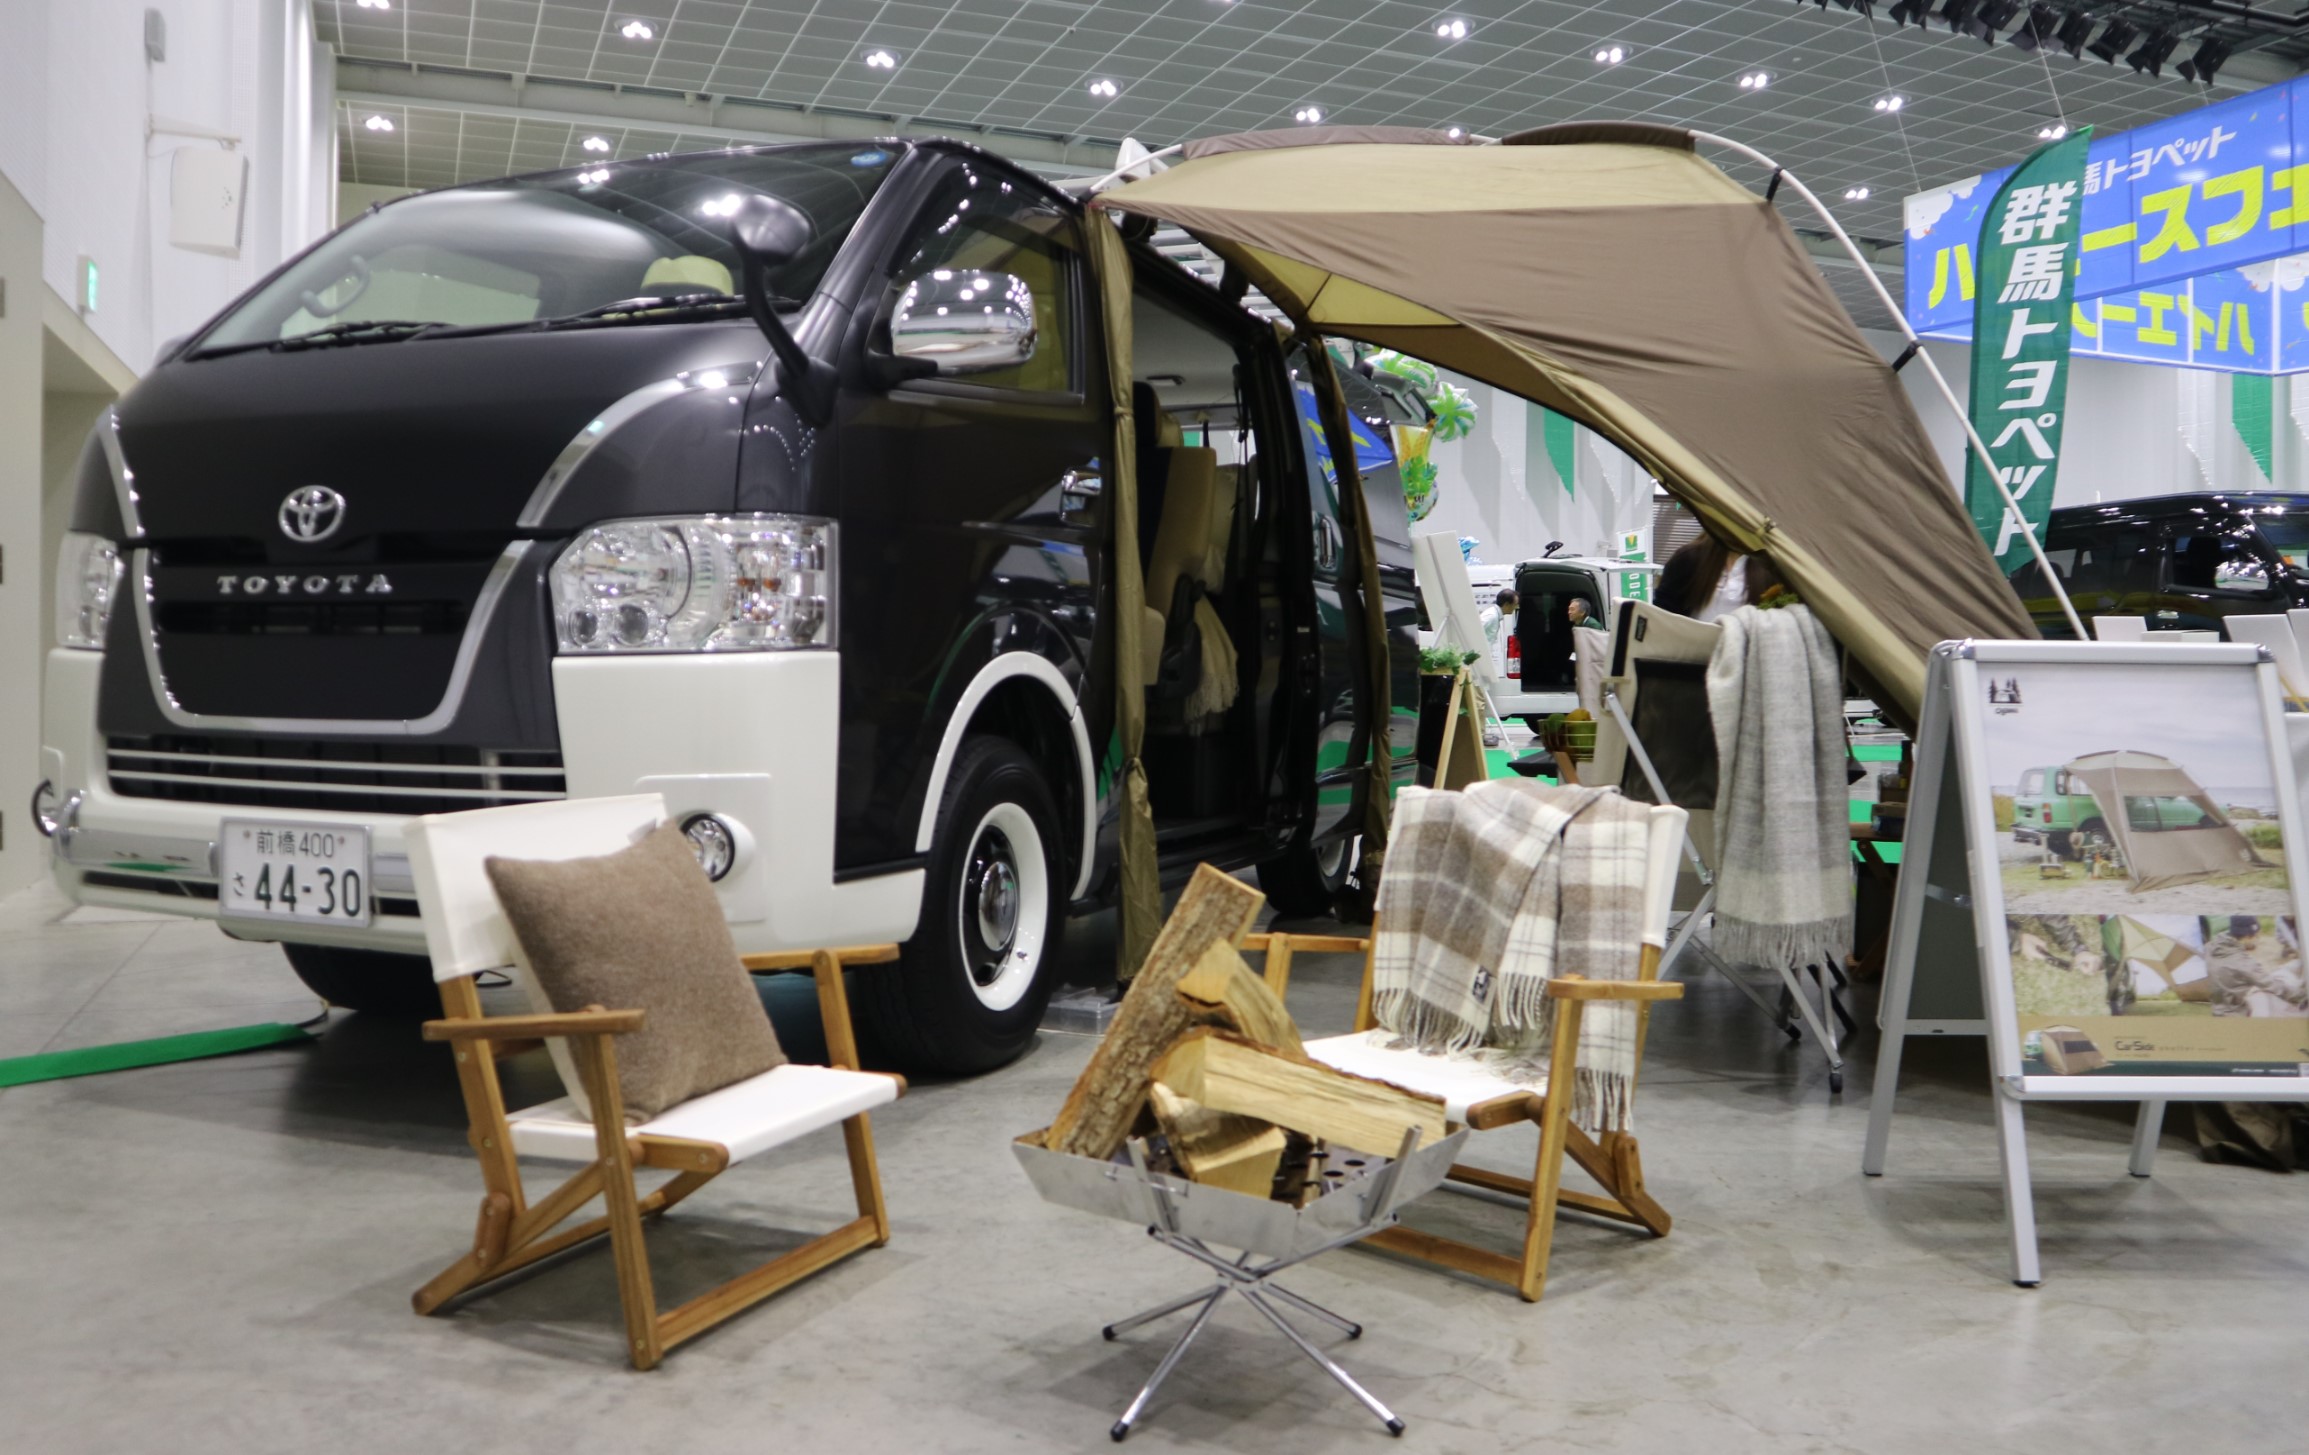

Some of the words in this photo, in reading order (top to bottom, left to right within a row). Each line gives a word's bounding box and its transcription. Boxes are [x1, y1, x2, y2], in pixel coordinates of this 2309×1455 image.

[2083, 125, 2238, 197] 馬トヨペット
[1990, 180, 2077, 557] 群馬トヨペット
[217, 574, 393, 595] TOYOTA
[233, 871, 245, 897] さ
[254, 862, 361, 918] 44-30
